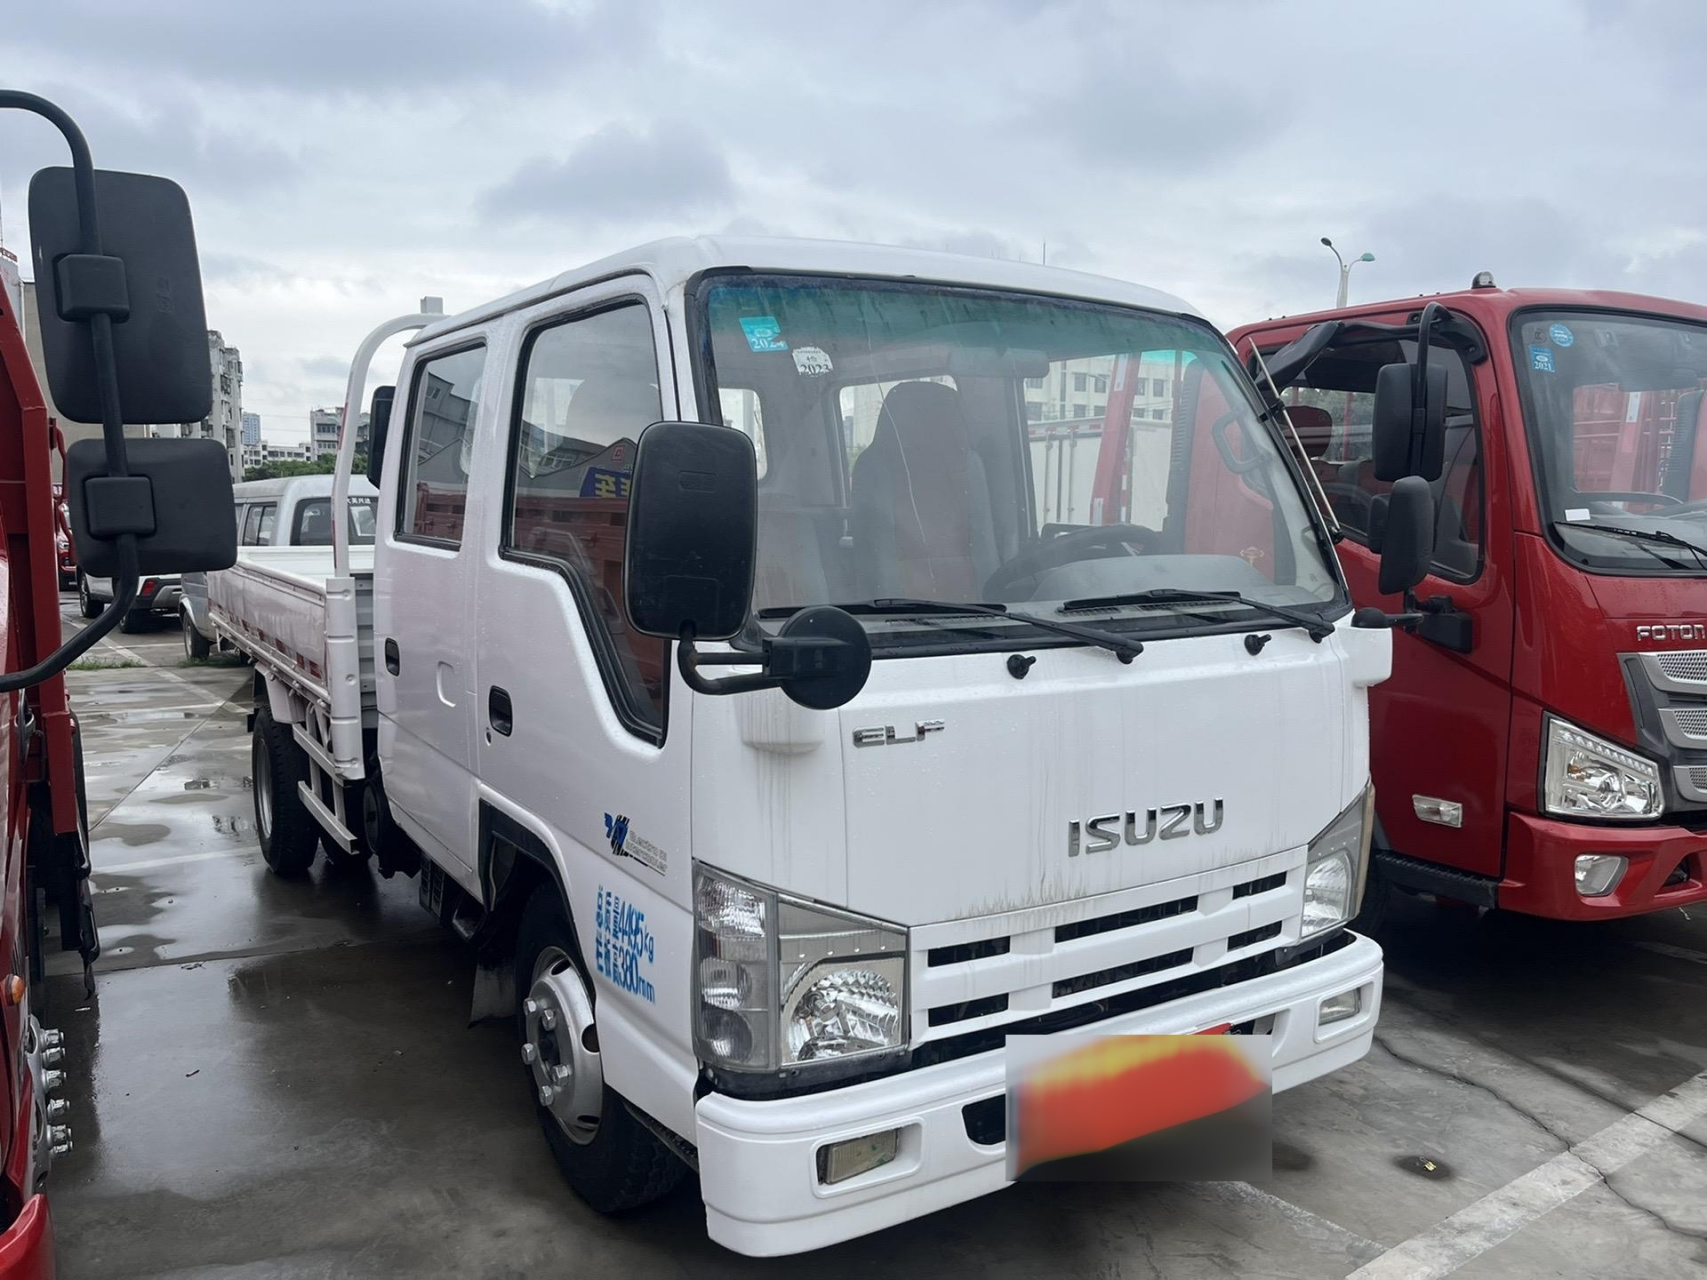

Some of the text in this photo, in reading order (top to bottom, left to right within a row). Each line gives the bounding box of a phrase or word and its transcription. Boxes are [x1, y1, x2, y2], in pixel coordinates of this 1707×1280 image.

[1534, 361, 1552, 371] 2021
[1636, 624, 1705, 641] FOTON
[852, 719, 945, 748] ELF
[1068, 797, 1223, 858] ISUZU
